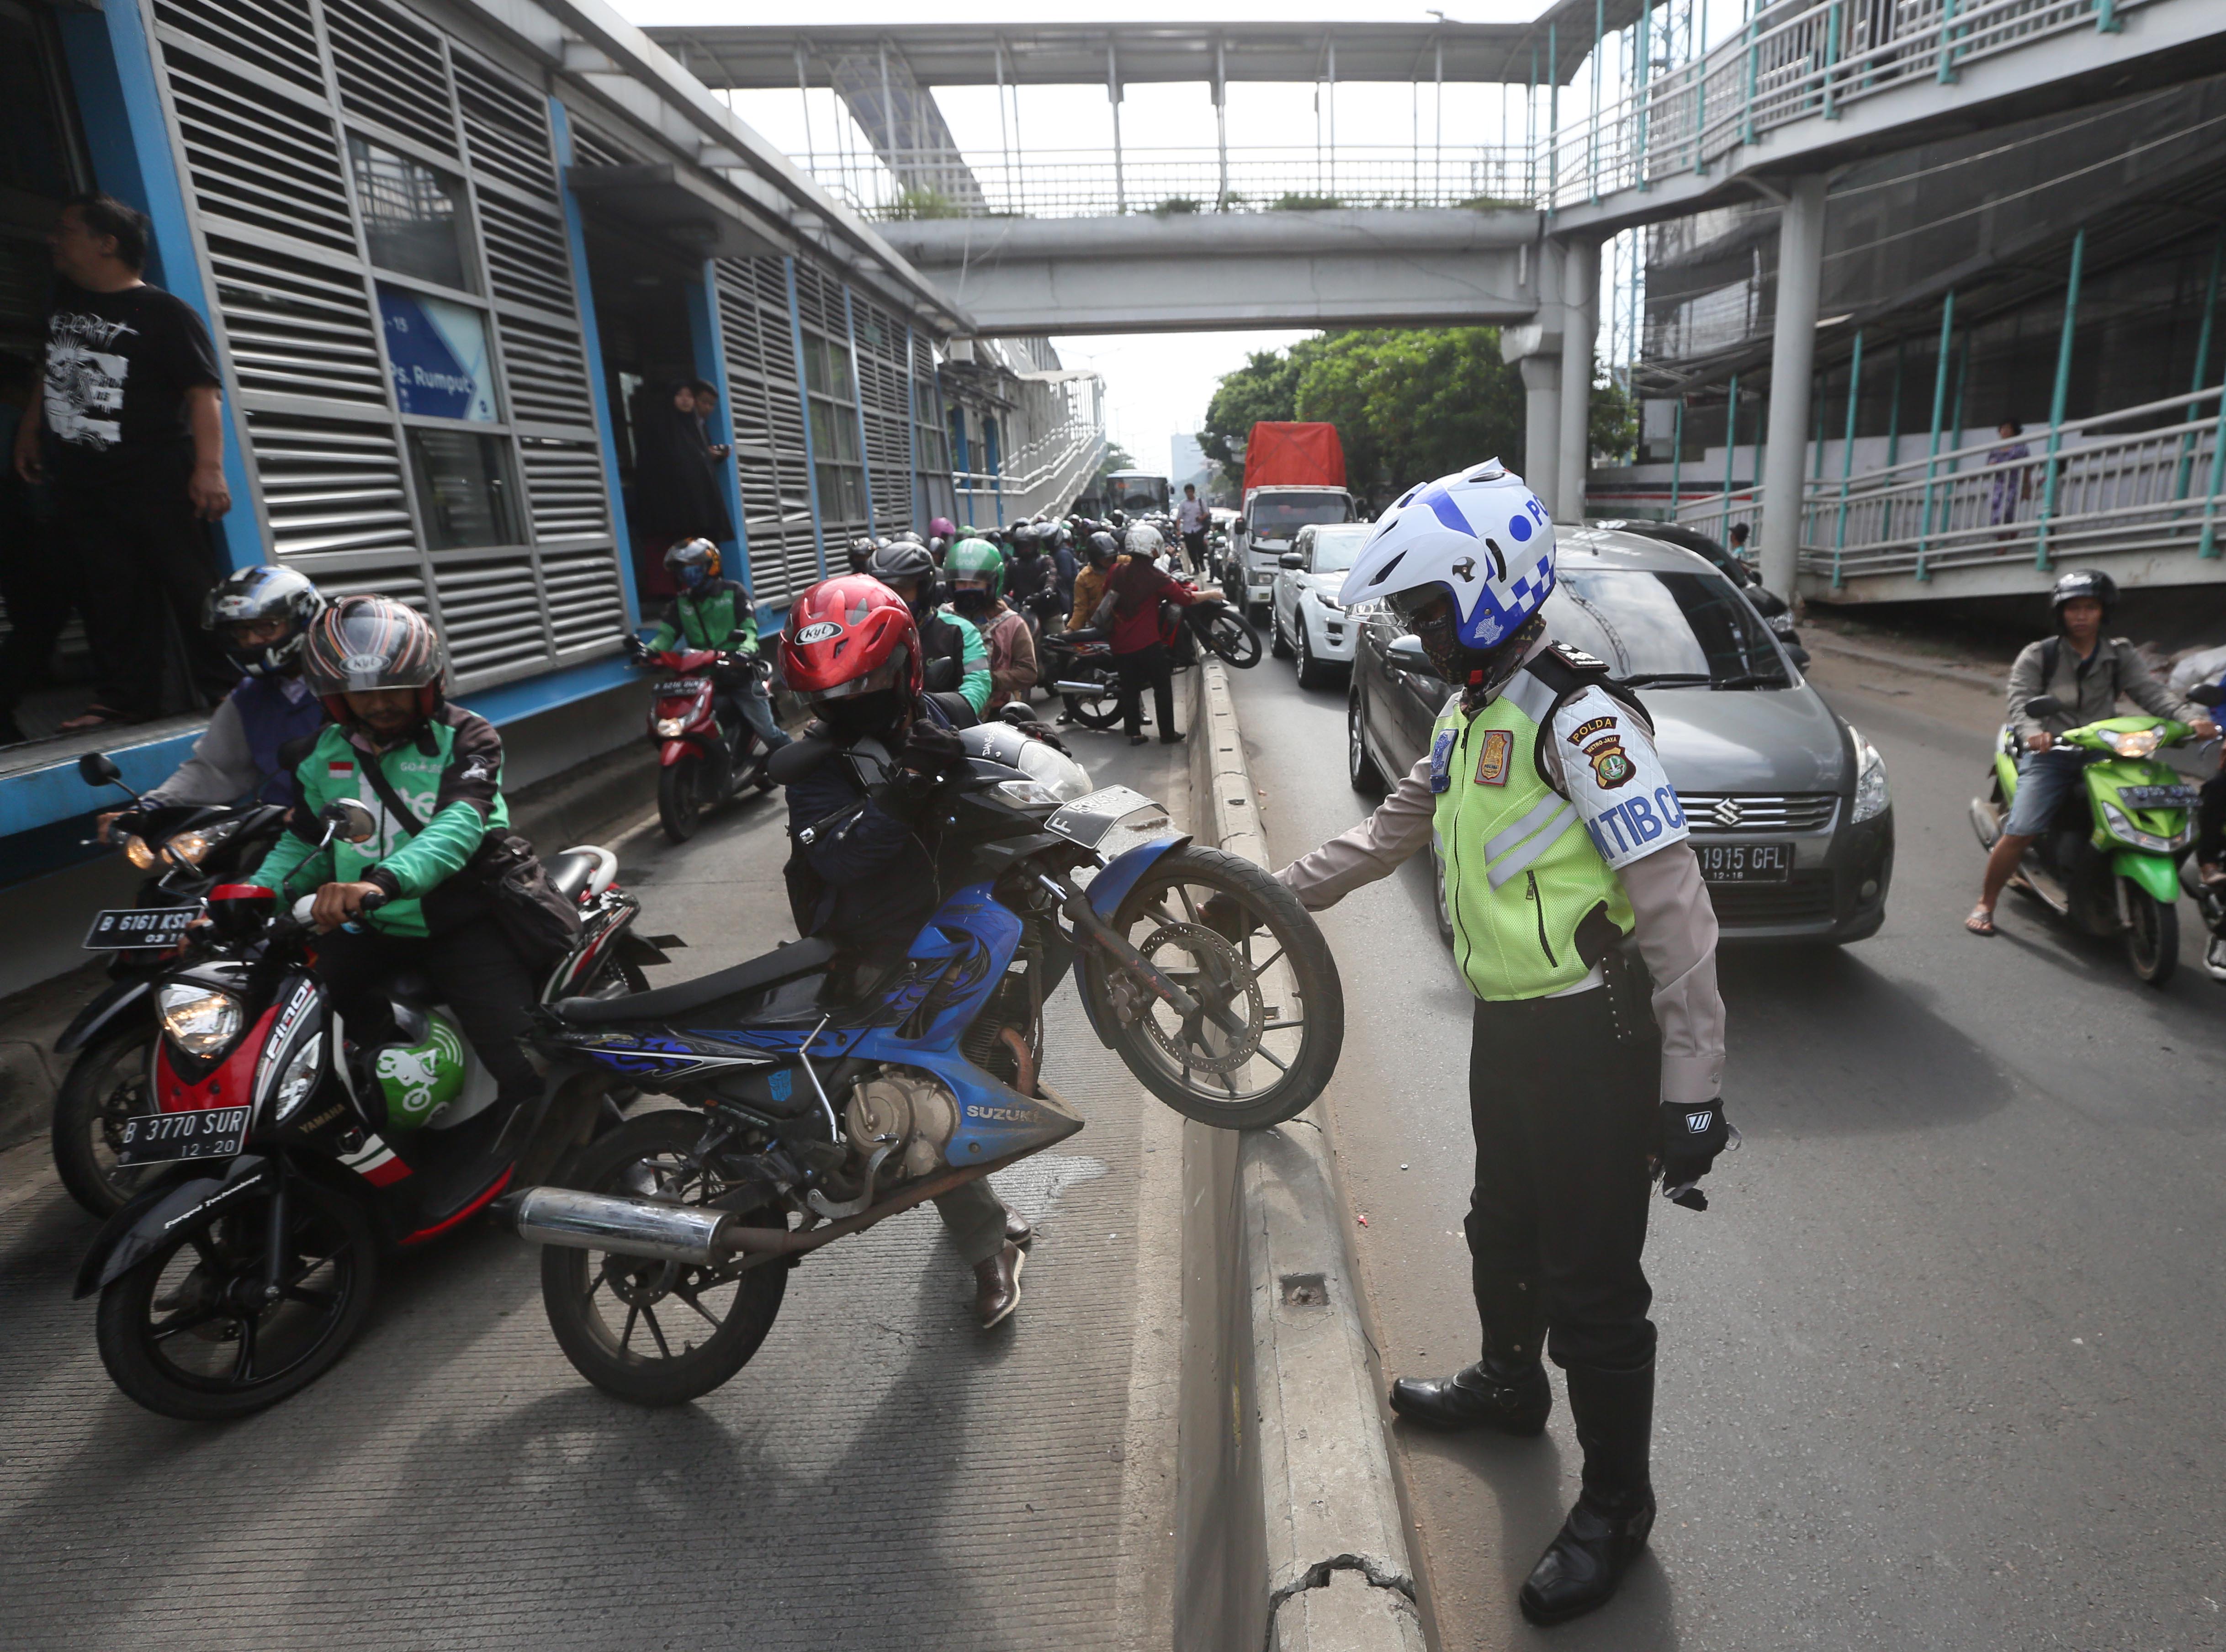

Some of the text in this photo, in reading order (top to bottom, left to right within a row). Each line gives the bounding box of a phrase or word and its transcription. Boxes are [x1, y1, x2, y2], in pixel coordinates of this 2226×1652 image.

[1572, 718, 1612, 742] POLDA
[1586, 736, 1617, 753] METRO-JAYA
[1051, 817, 1072, 834] F
[1704, 847, 1784, 869] 1915 GFL
[99, 916, 114, 931] B
[119, 915, 159, 931] 6161
[966, 1105, 1039, 1123] SUZUKI
[122, 1111, 244, 1143] B 3770 SUR
